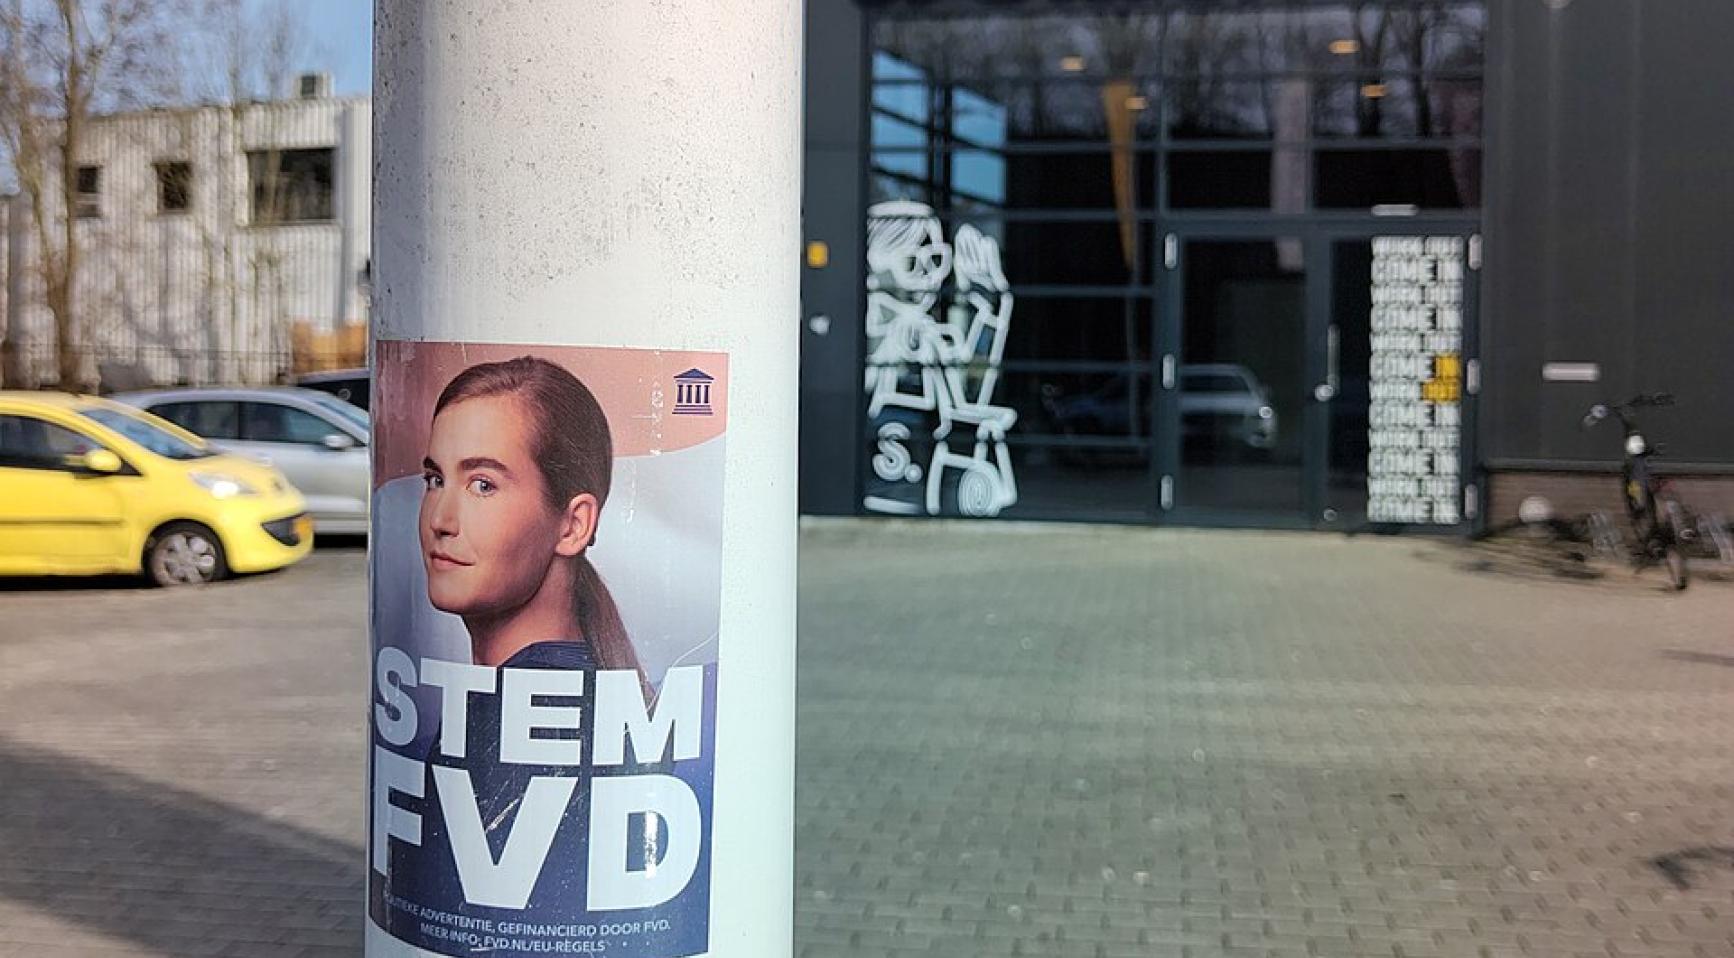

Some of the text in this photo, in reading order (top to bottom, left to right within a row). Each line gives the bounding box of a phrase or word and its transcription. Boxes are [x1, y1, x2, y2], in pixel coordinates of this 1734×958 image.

[1371, 255, 1436, 282] COME
[1370, 304, 1435, 330] COME
[1369, 351, 1434, 378] COME
[1368, 401, 1433, 427] COME
[1368, 449, 1433, 475] COME
[1367, 497, 1432, 523] COME
[375, 646, 704, 766] STEM
[373, 744, 702, 912] FVD
[420, 907, 495, 933] ADVERTENTIE,
[498, 922, 597, 937] GEFINANCIERD
[600, 922, 640, 936] DOOR
[644, 919, 671, 933] FVD.
[420, 923, 448, 939] MEER
[484, 936, 606, 952] FVD.NL/EU-REGELS
